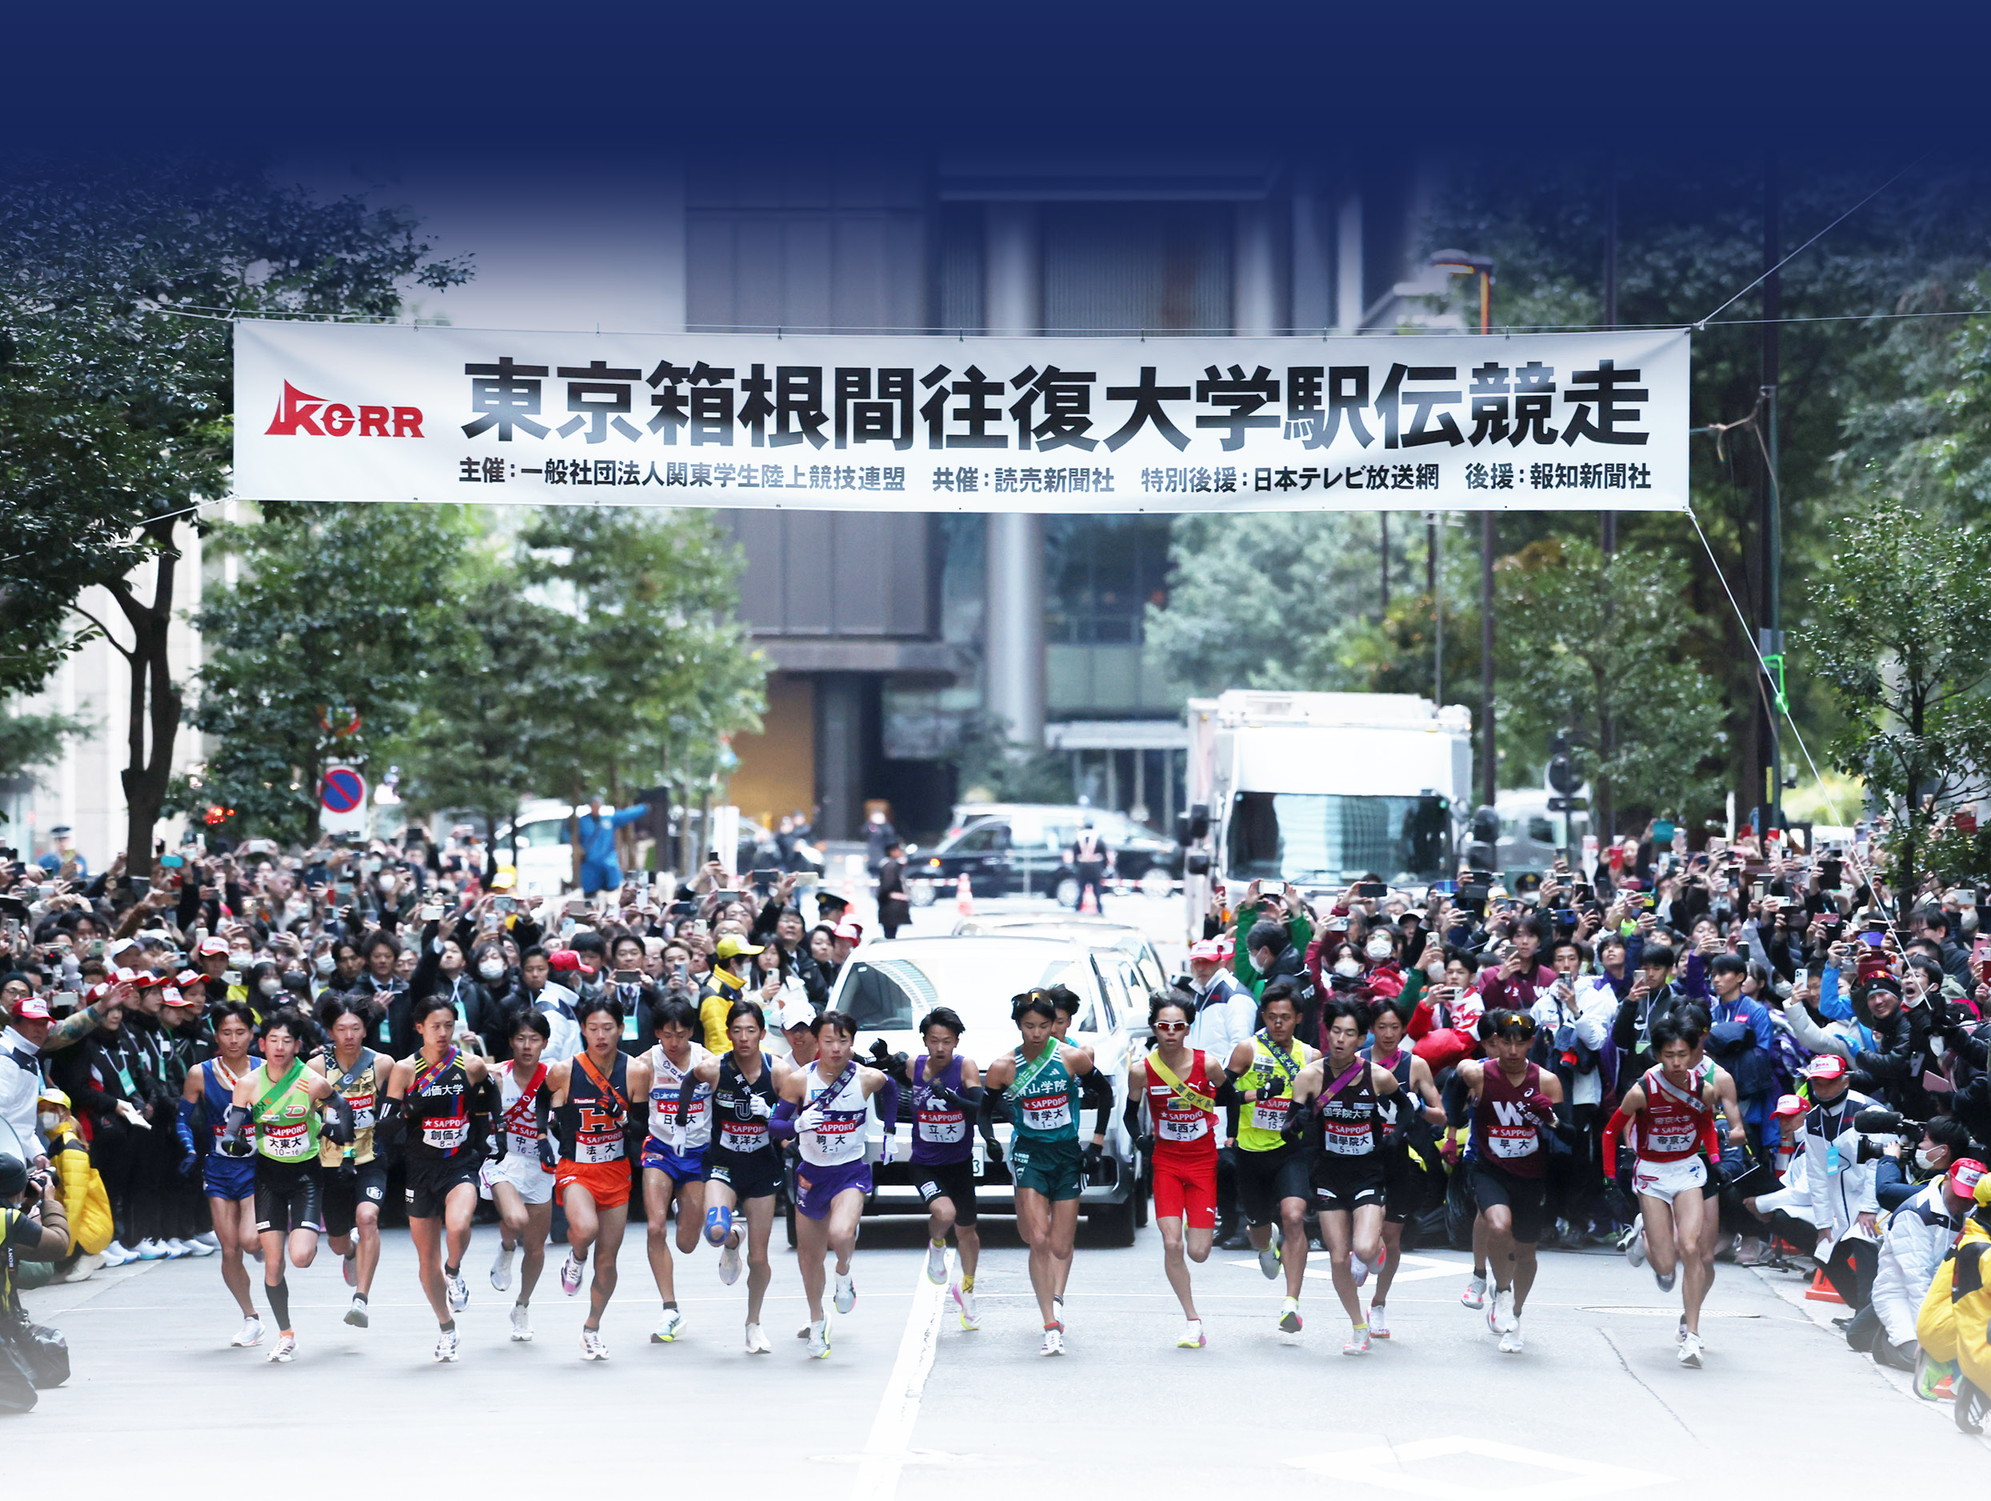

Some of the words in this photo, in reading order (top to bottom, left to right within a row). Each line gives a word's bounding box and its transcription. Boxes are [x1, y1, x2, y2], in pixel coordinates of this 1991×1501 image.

[461, 357, 1649, 453] 東京箱根間往復大学駅伝競走
[666, 1103, 703, 1112] SAORO
[1032, 1095, 1067, 1109] SAPPORO
[579, 1107, 617, 1133] H
[663, 1114, 696, 1125] 日大
[928, 1113, 963, 1122] SAPPORO
[1030, 1109, 1064, 1121] 青学大
[1169, 1110, 1203, 1121] SAPPORO
[272, 1123, 307, 1137] SAPPORO
[817, 1122, 854, 1132] SAPPORO
[929, 1124, 957, 1135] 立大
[1167, 1123, 1199, 1133] 城西大
[1335, 1125, 1370, 1135] SAPPORO
[1661, 1123, 1694, 1134] SAPPORO
[268, 1136, 302, 1149] 大東大
[586, 1131, 624, 1144] SAPPORO
[728, 1134, 762, 1146] 東洋大
[816, 1134, 846, 1145] 駒大
[1328, 1135, 1370, 1147] 國學院大
[1657, 1135, 1691, 1146] 帝京大
[1499, 1139, 1530, 1150] 早大
